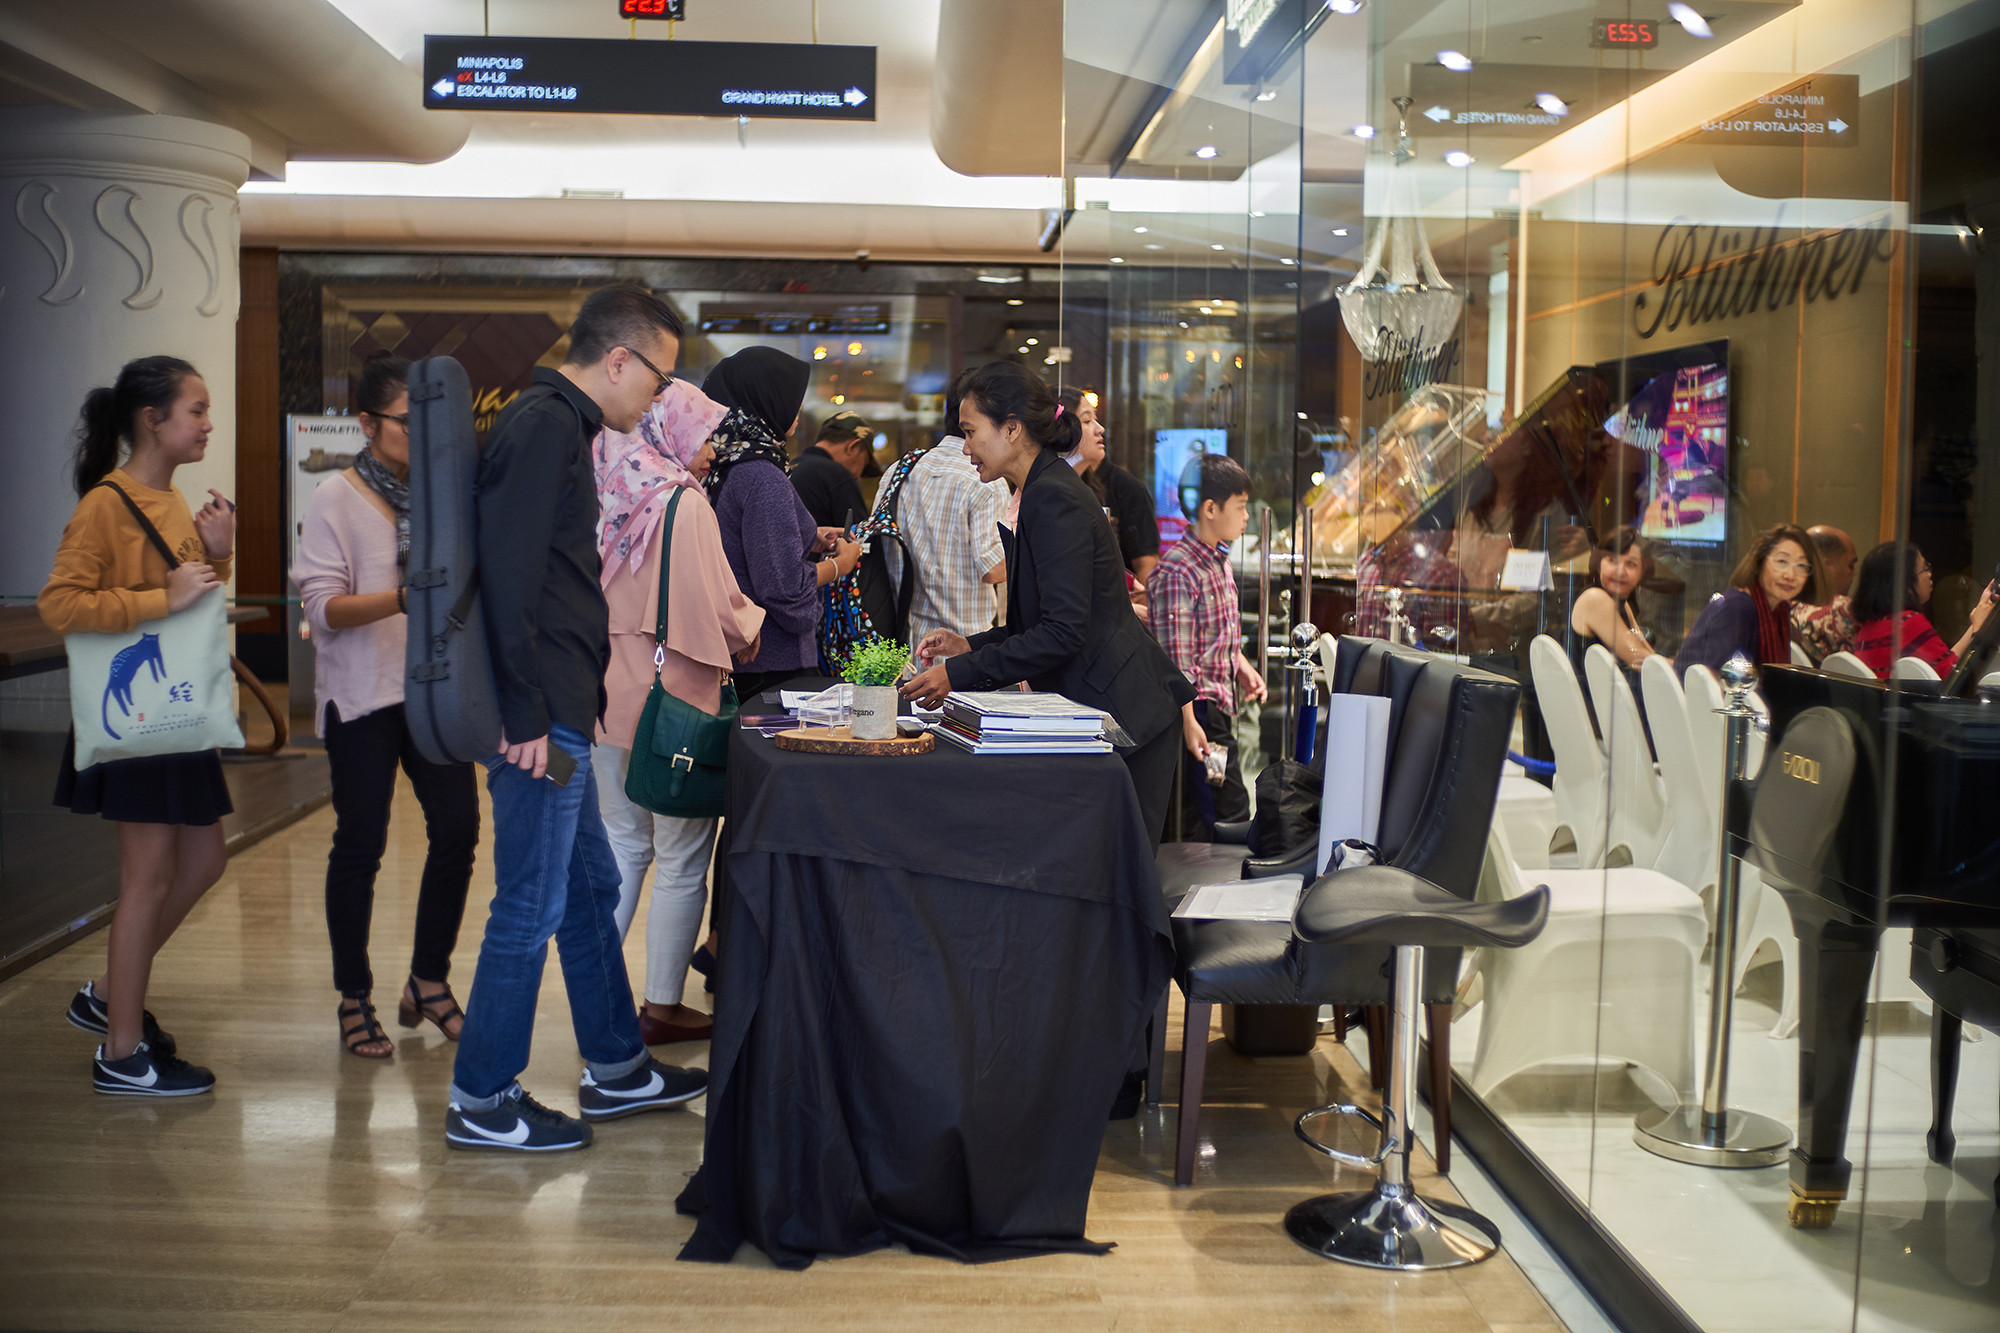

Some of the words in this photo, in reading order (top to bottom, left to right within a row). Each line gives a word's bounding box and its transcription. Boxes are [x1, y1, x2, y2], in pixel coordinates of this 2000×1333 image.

[457, 56, 524, 70] MINIAPOLIS
[457, 85, 527, 98] ESCALATOR
[527, 86, 545, 99] TO
[721, 91, 765, 104] GRAND
[765, 93, 803, 106] HYATT
[803, 94, 843, 107] HOTEL
[1633, 202, 1900, 340] Blüthner
[1364, 325, 1460, 401] Blüthner
